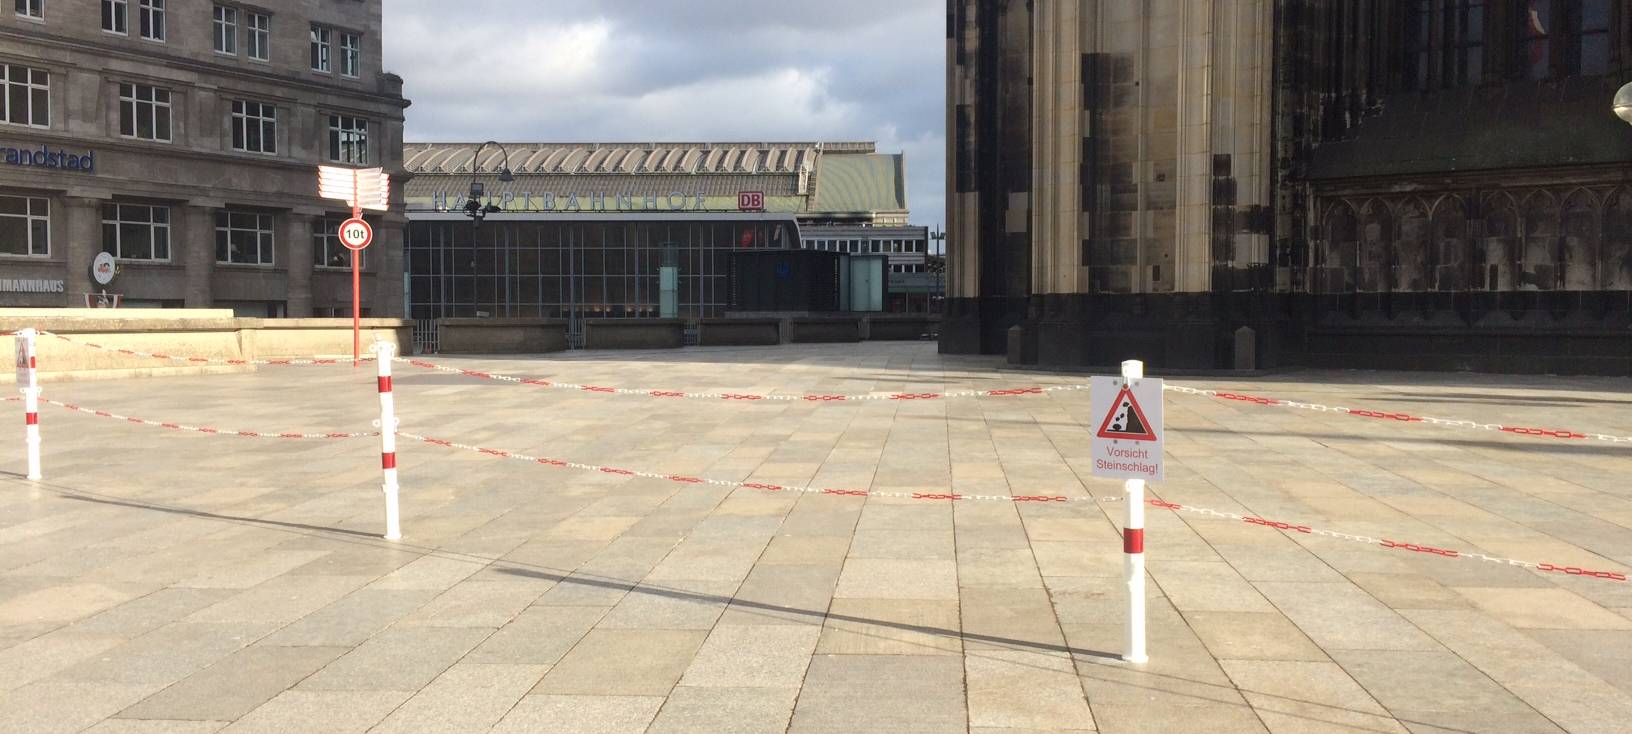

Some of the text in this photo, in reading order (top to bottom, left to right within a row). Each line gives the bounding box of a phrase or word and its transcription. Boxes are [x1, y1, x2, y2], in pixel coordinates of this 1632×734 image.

[741, 194, 761, 207] DB
[346, 229, 365, 239] 10t
[0, 279, 64, 292] MANNHAUS
[1106, 446, 1148, 459] Vorsicht
[1096, 459, 1158, 475] Steinschlag!
